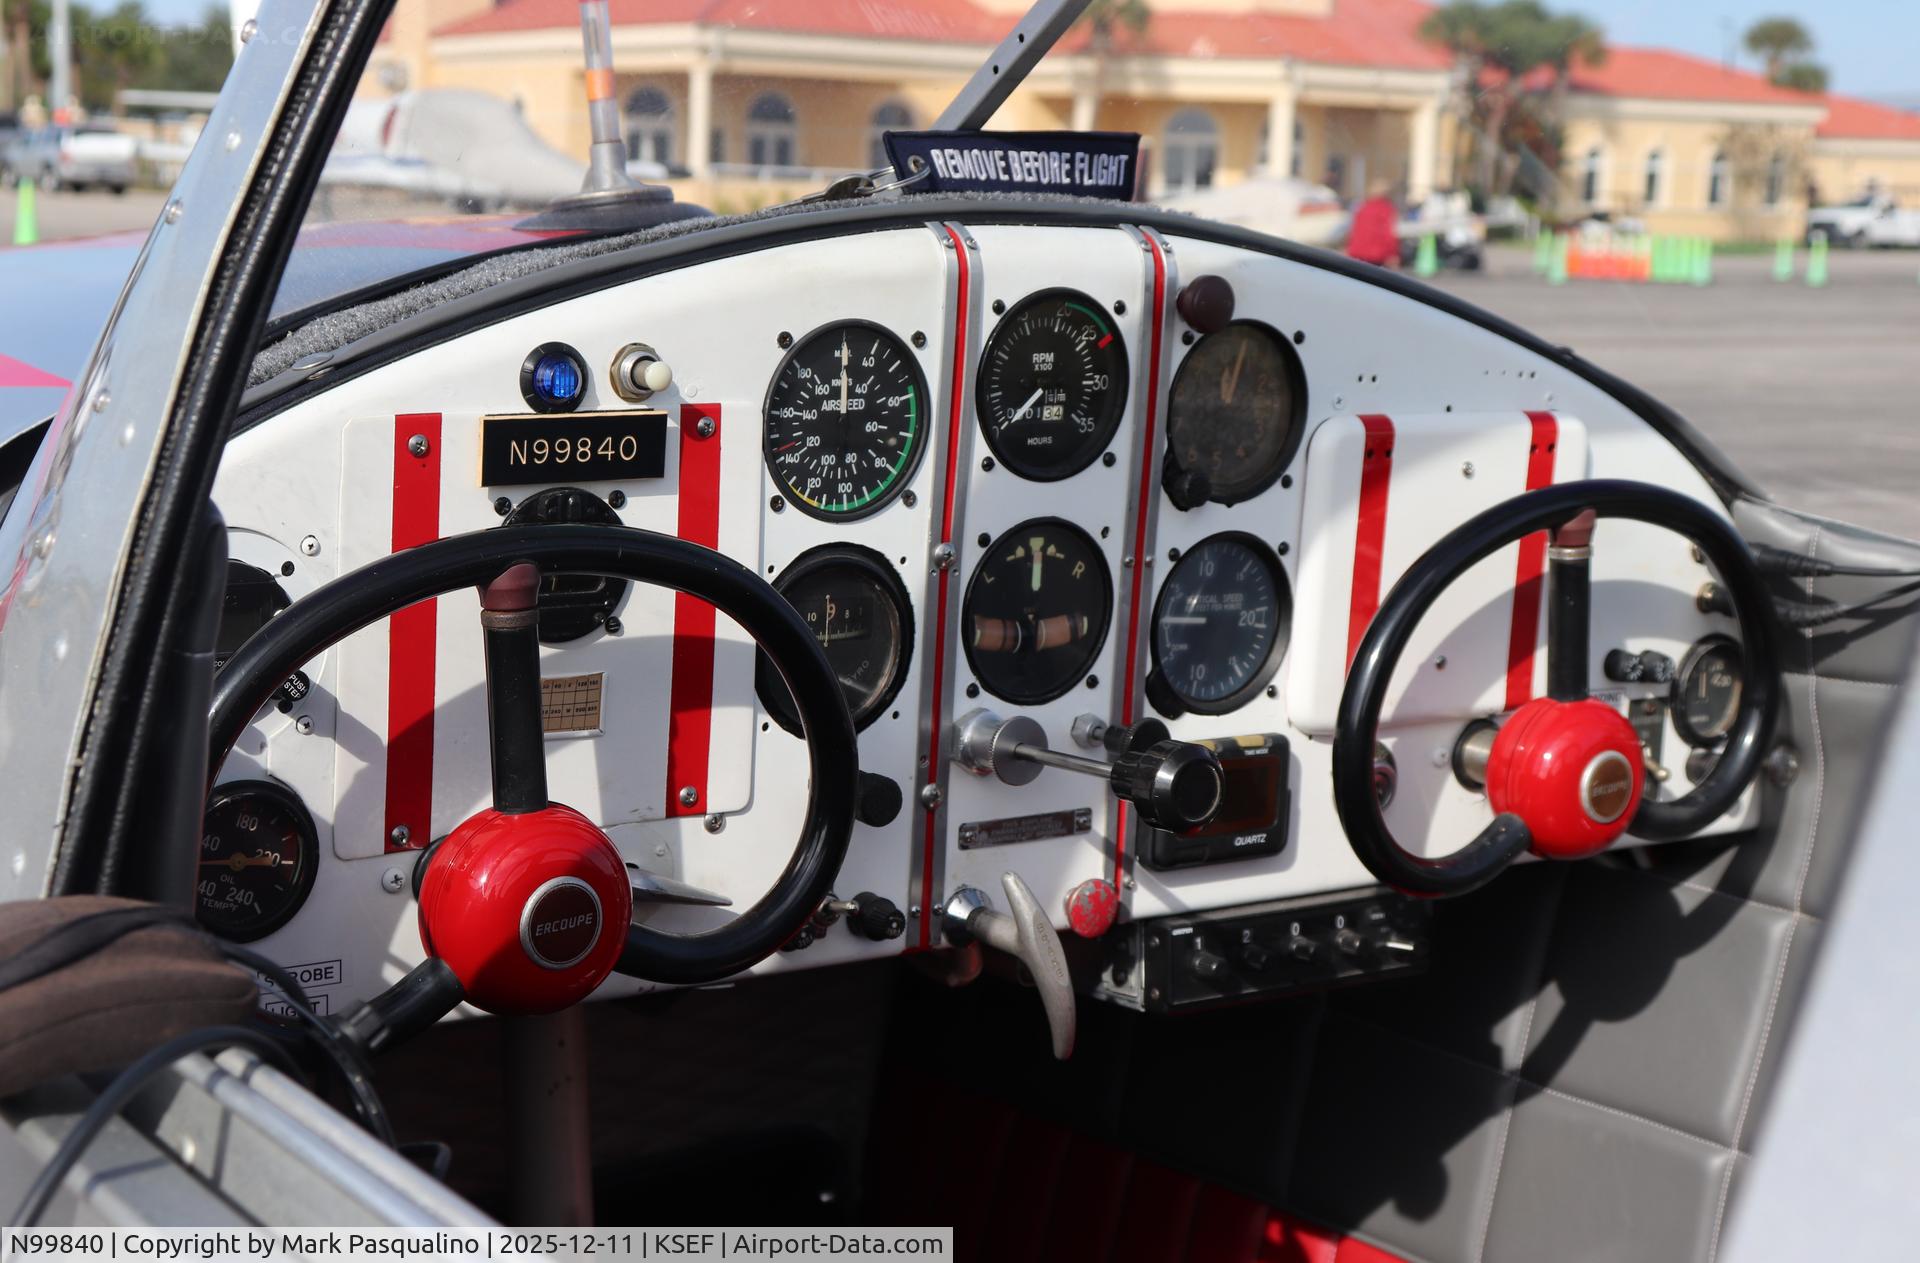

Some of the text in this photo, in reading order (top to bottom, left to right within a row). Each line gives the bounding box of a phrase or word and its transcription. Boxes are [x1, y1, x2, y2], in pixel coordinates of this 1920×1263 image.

[930, 148, 1129, 187] REMOVE BEFORE FLIGHT
[1081, 326, 1097, 341] 25
[862, 356, 875, 367] 40
[1032, 352, 1054, 364] RPM
[798, 368, 812, 379] 180
[832, 378, 853, 387] KNS
[855, 383, 868, 394] 40
[1093, 375, 1109, 391] 30
[815, 384, 829, 395] 160
[821, 399, 865, 411] AIRSEED
[888, 397, 900, 408] 60
[780, 406, 794, 418] 160
[803, 409, 817, 420] 140
[865, 421, 878, 432] 60
[1079, 417, 1095, 433] 35
[806, 435, 820, 447] 120
[1027, 436, 1053, 446] HOURS
[510, 435, 638, 466] N99840
[785, 452, 799, 464] 140
[821, 453, 836, 464] 100
[845, 452, 857, 463] 80
[874, 457, 886, 468] 80
[807, 476, 821, 488] 120
[838, 482, 852, 493] 100
[1071, 560, 1085, 579] R
[1199, 561, 1215, 577] 10
[983, 571, 995, 584] L
[807, 612, 817, 622] 10
[827, 602, 836, 620] 9
[1238, 610, 1256, 627] 20
[1190, 664, 1206, 680] 10
[289, 673, 307, 693] PUSH
[283, 682, 301, 699] STEP
[236, 812, 259, 832] 180
[1234, 833, 1268, 847] QUARTZ
[220, 873, 235, 885] OIL
[225, 887, 254, 906] 240
[535, 912, 594, 937] ERCOUPE
[1242, 930, 1251, 943] 2
[264, 966, 334, 988] SROBE
[271, 1001, 321, 1017] IGT
